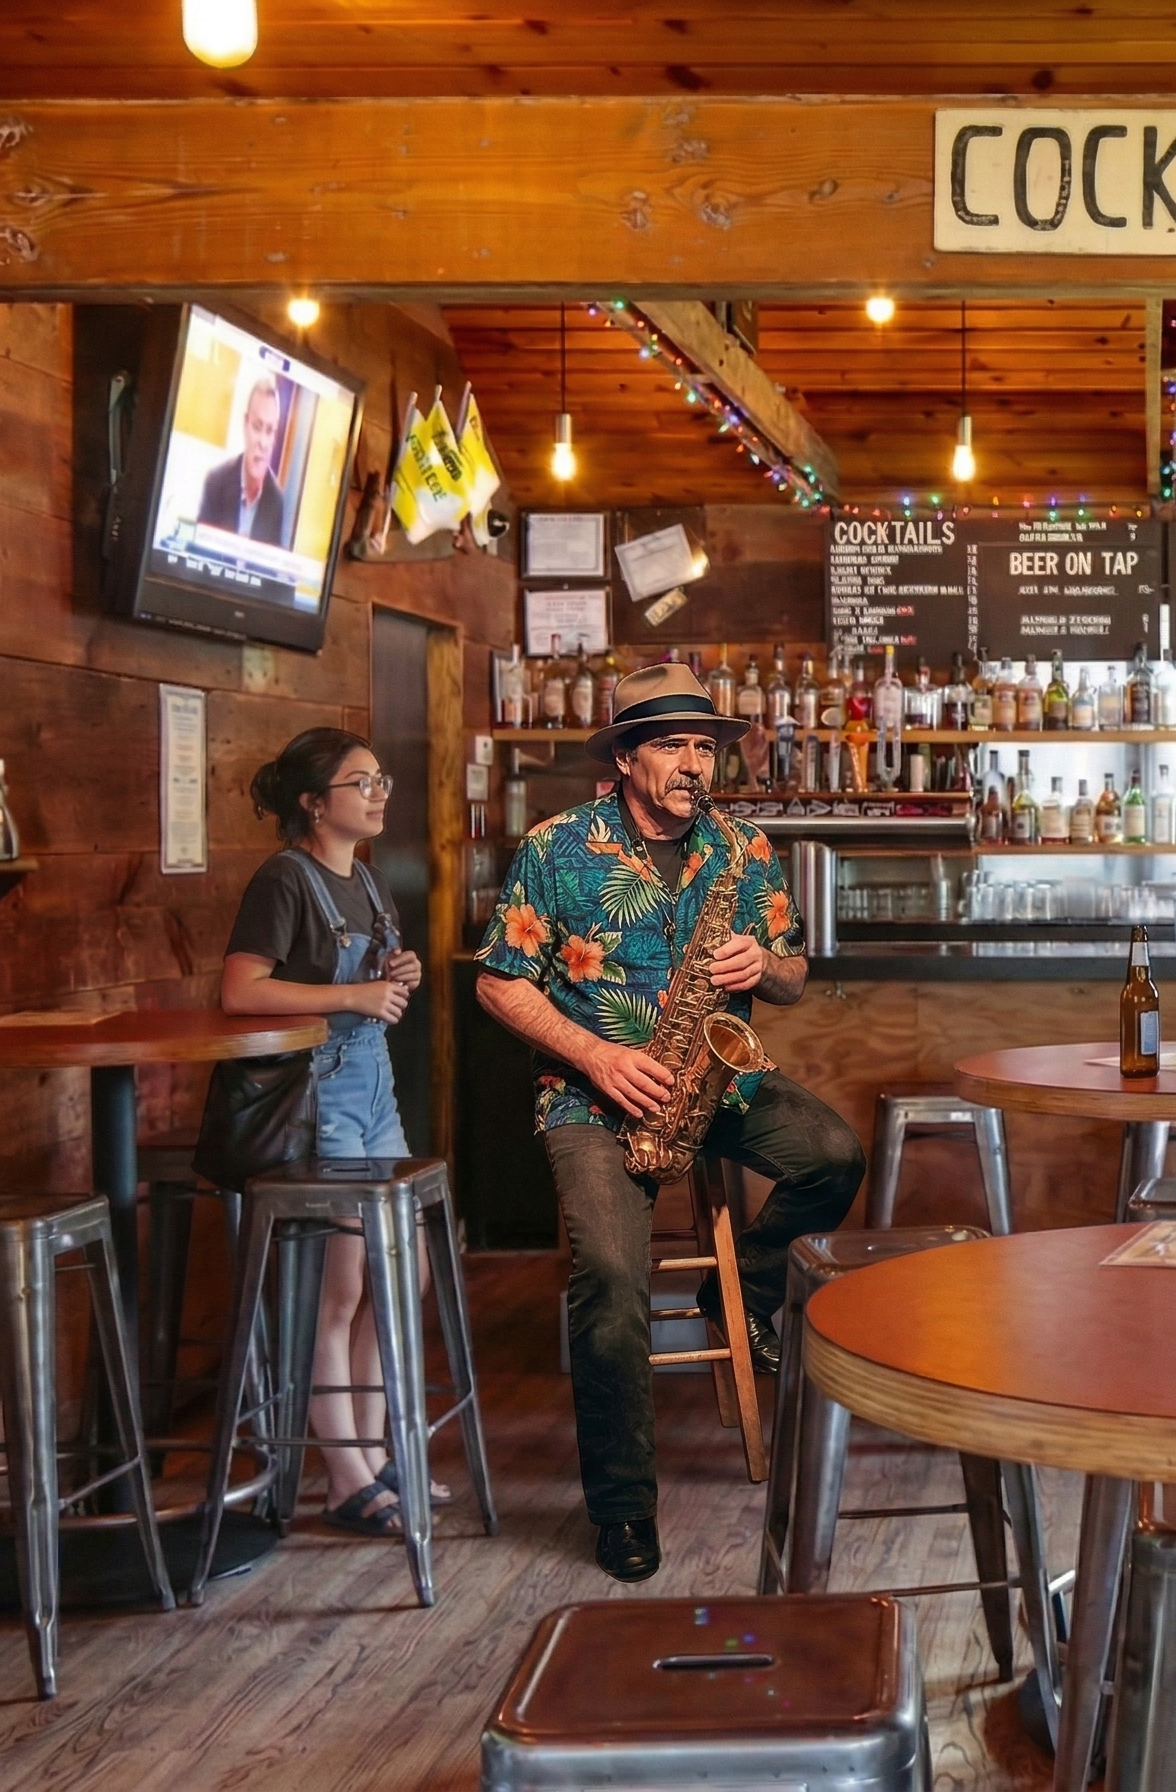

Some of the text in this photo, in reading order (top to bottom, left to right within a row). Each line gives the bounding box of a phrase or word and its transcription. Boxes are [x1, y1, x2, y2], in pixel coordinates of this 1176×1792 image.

[834, 521, 956, 545] COCKTAILS
[1009, 552, 1140, 575] BEER ON TAP
